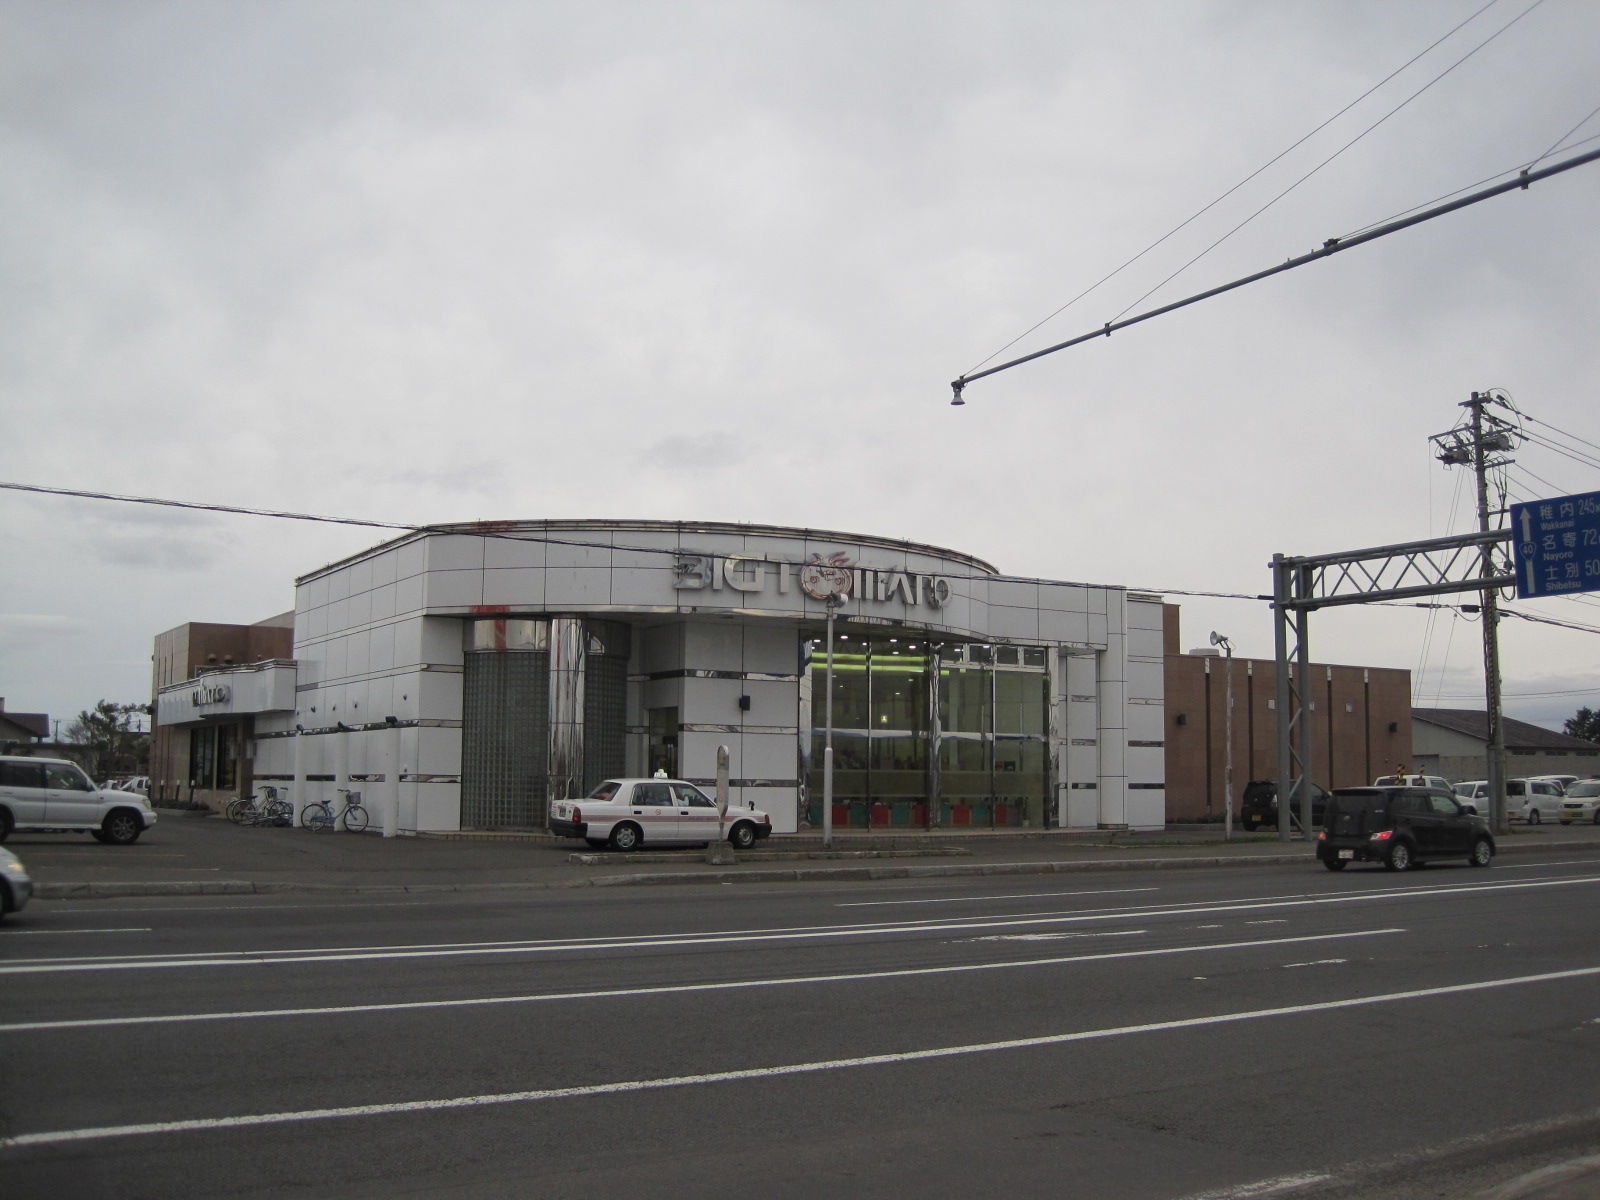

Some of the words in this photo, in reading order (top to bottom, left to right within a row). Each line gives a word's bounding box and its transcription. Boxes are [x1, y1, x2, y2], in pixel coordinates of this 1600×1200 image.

[1540, 502, 1574, 519] 稚内
[1543, 532, 1576, 549] 名寄
[1582, 529, 1600, 545] 72
[1544, 552, 1573, 561] Nayoro
[1545, 563, 1579, 580] 士別
[1546, 581, 1581, 591] Shibetsu
